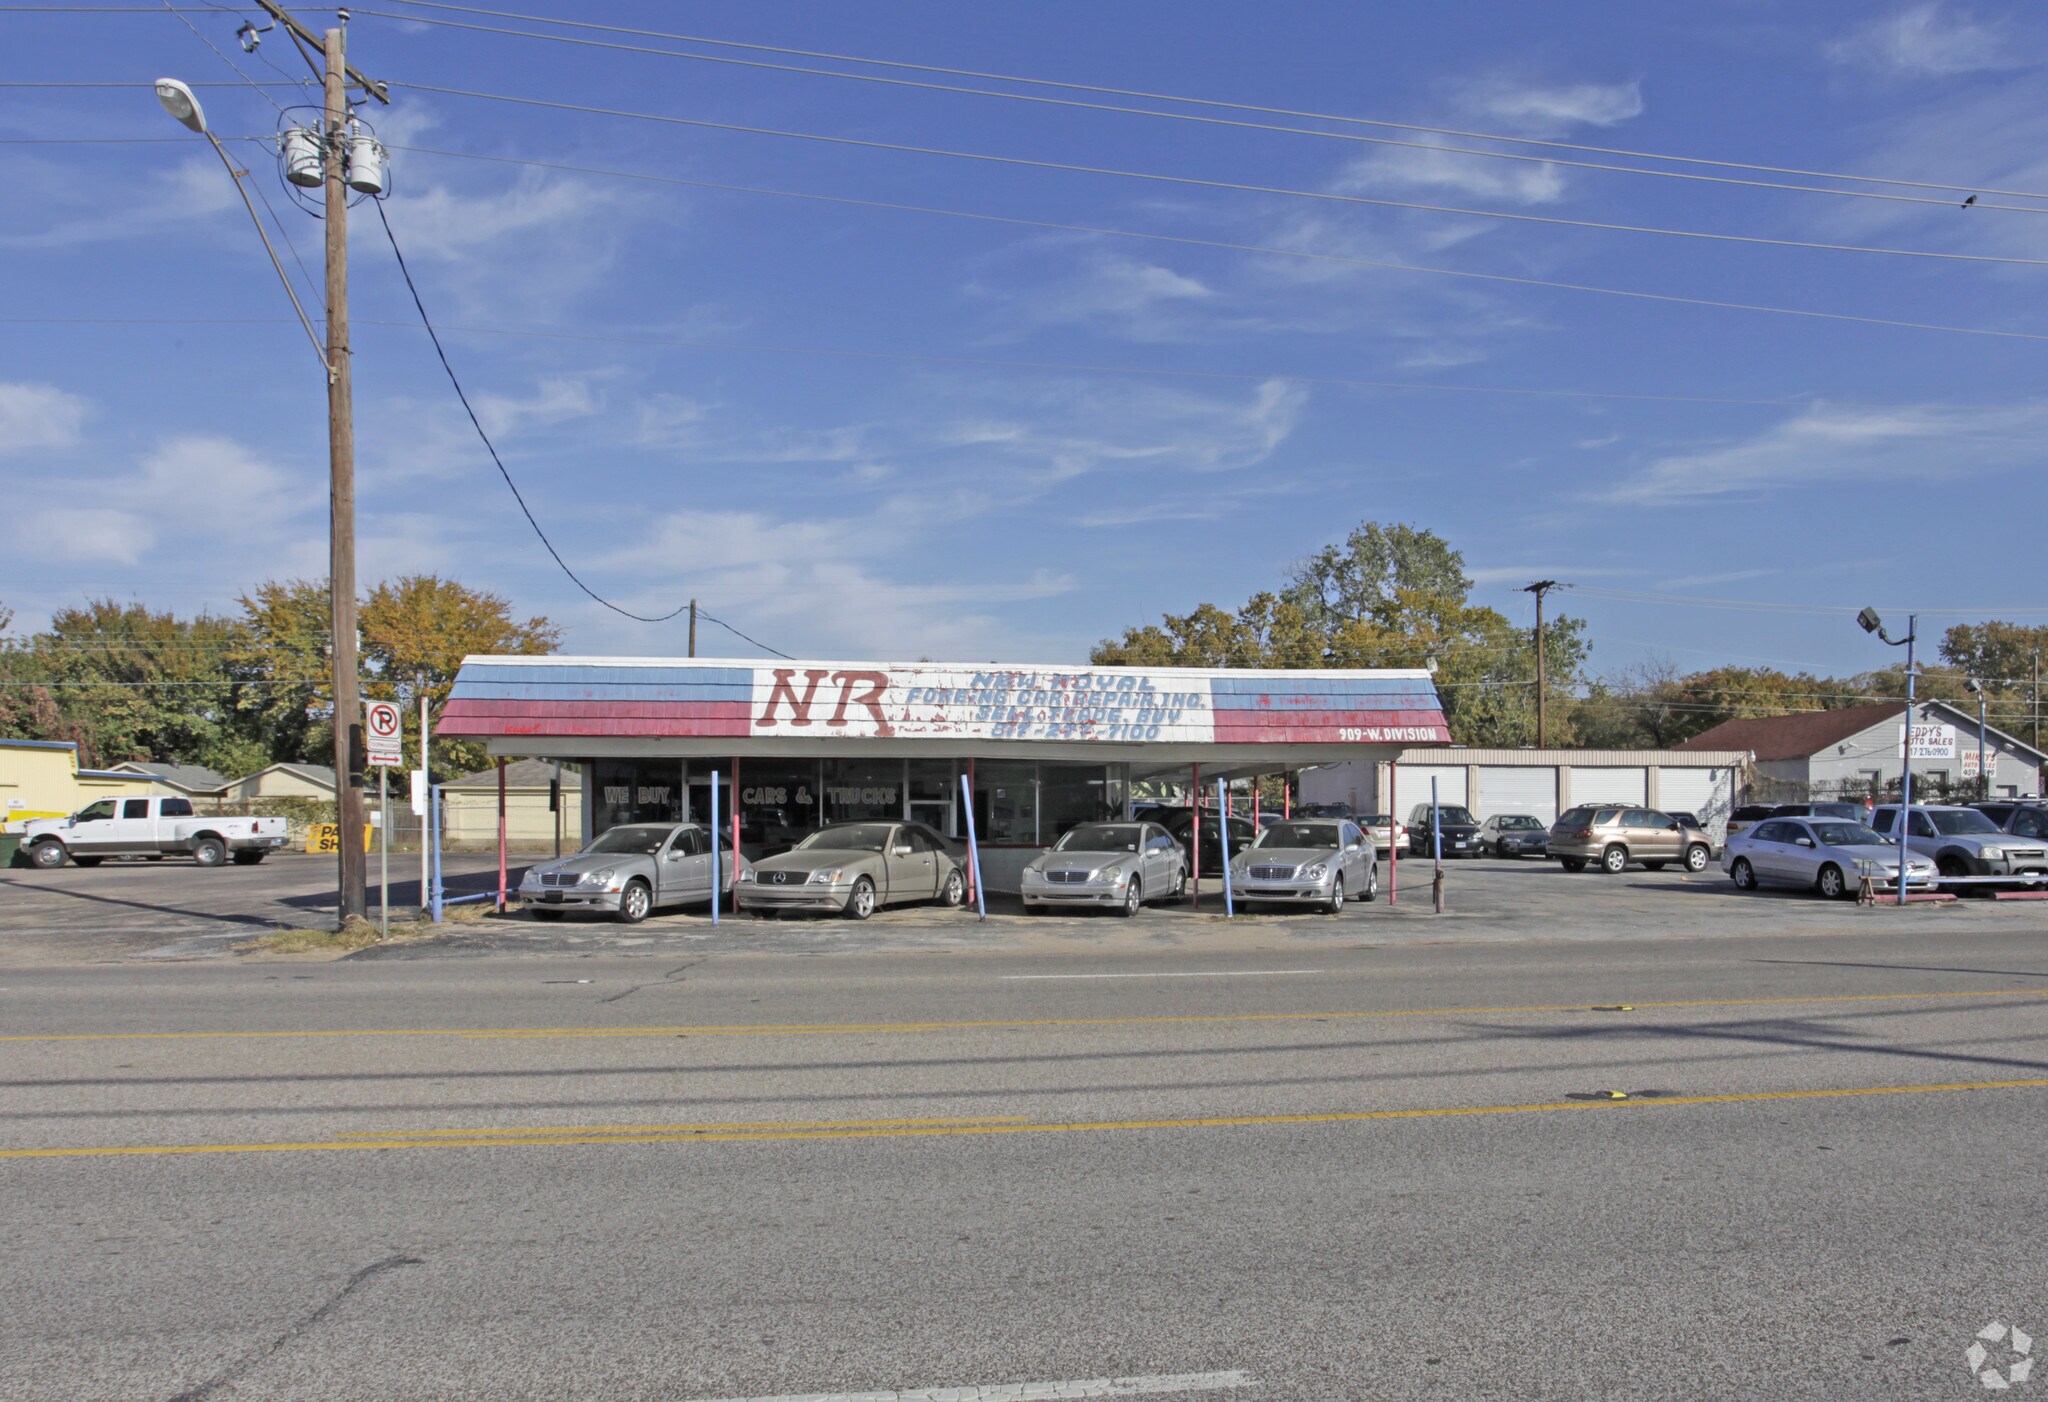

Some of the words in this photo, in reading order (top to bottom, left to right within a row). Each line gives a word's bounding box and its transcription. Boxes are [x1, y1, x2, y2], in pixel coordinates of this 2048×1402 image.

[970, 673, 1037, 690] NEW
[1051, 675, 1156, 691] ROYAL
[1017, 690, 1064, 706] CAR
[1136, 708, 1183, 724] BUY
[1384, 727, 1437, 741] DIVISION
[1909, 738, 1925, 746] UTO
[1928, 738, 1954, 746] SALES
[604, 786, 629, 804] WE
[638, 786, 670, 805] BUY
[742, 787, 788, 805] CARS
[795, 786, 813, 805] &
[827, 787, 897, 805] TRUCKS
